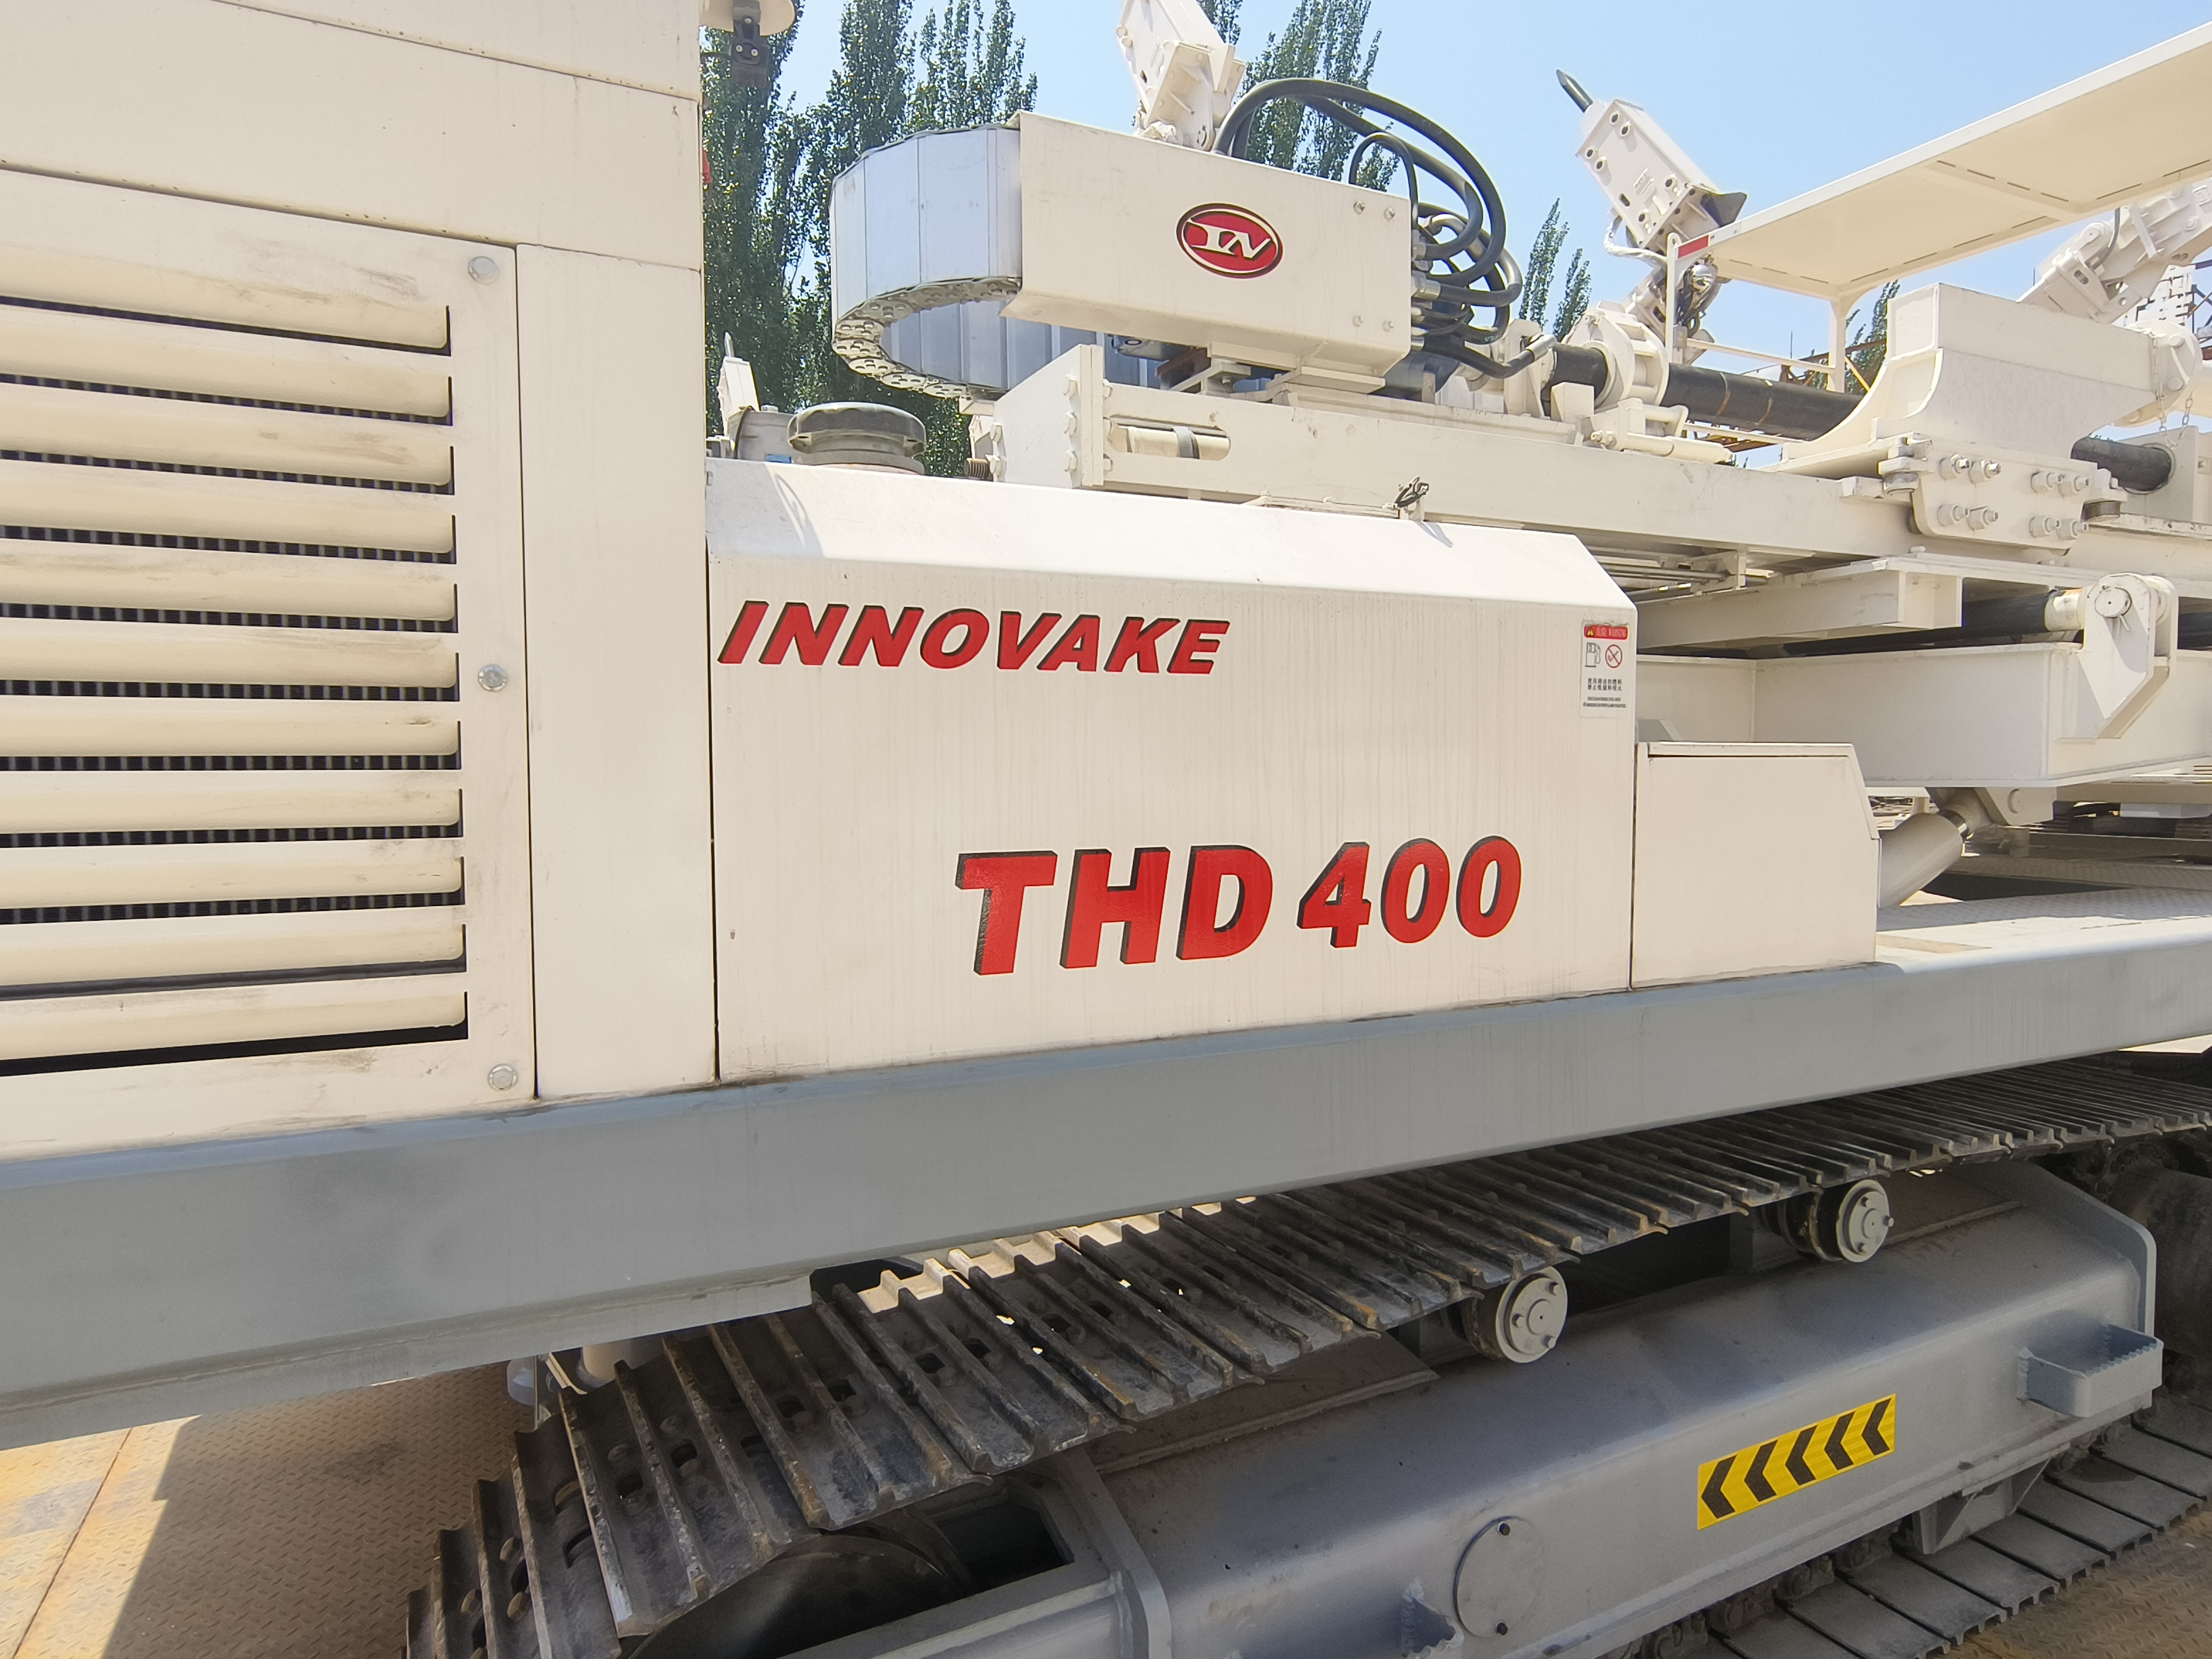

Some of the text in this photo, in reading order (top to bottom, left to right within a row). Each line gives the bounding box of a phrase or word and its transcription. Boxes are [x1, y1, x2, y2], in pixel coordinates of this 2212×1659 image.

[718, 601, 1231, 674] INNOVAKE
[955, 835, 1522, 976] THD 400
